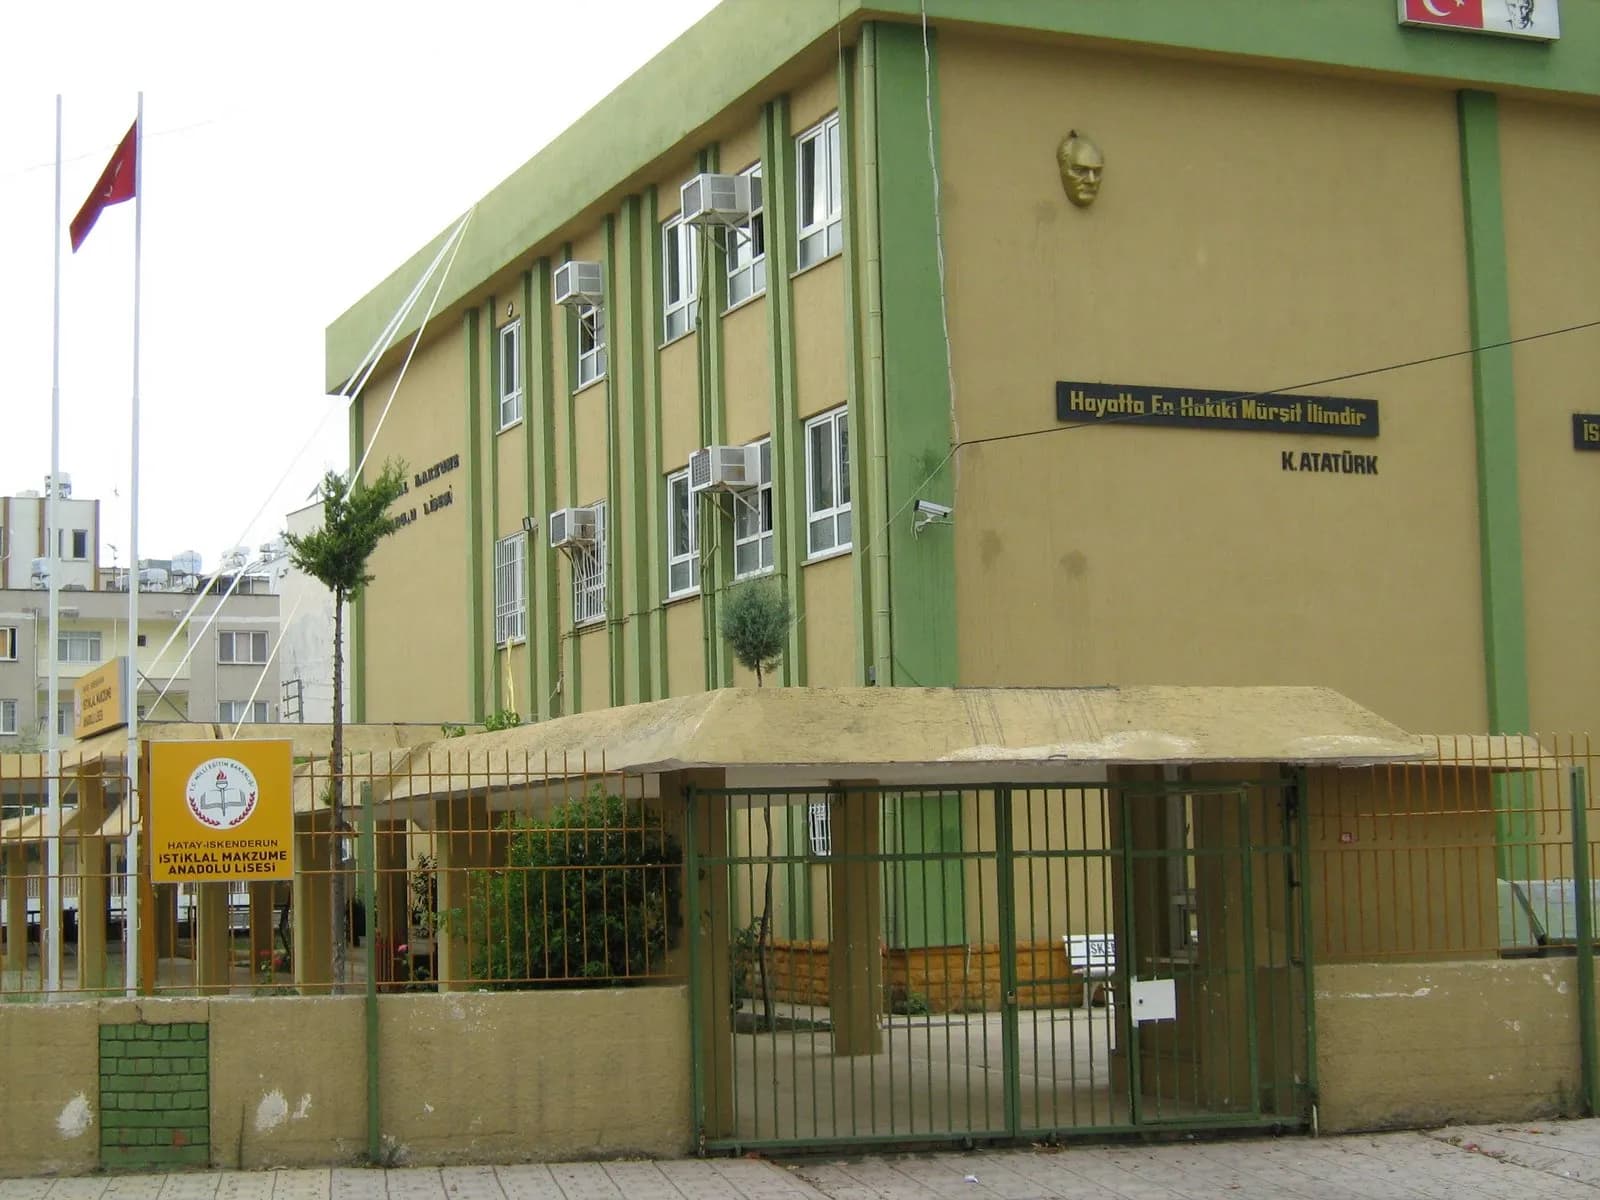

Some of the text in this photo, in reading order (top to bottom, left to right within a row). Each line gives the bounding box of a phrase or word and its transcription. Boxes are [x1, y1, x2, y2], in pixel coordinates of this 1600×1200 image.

[1070, 390, 1145, 418] Hayatta
[1151, 394, 1174, 416] En
[1299, 450, 1378, 475] ATATÜRK
[222, 851, 287, 862] MAKZUME
[168, 864, 231, 875] ANADOLU
